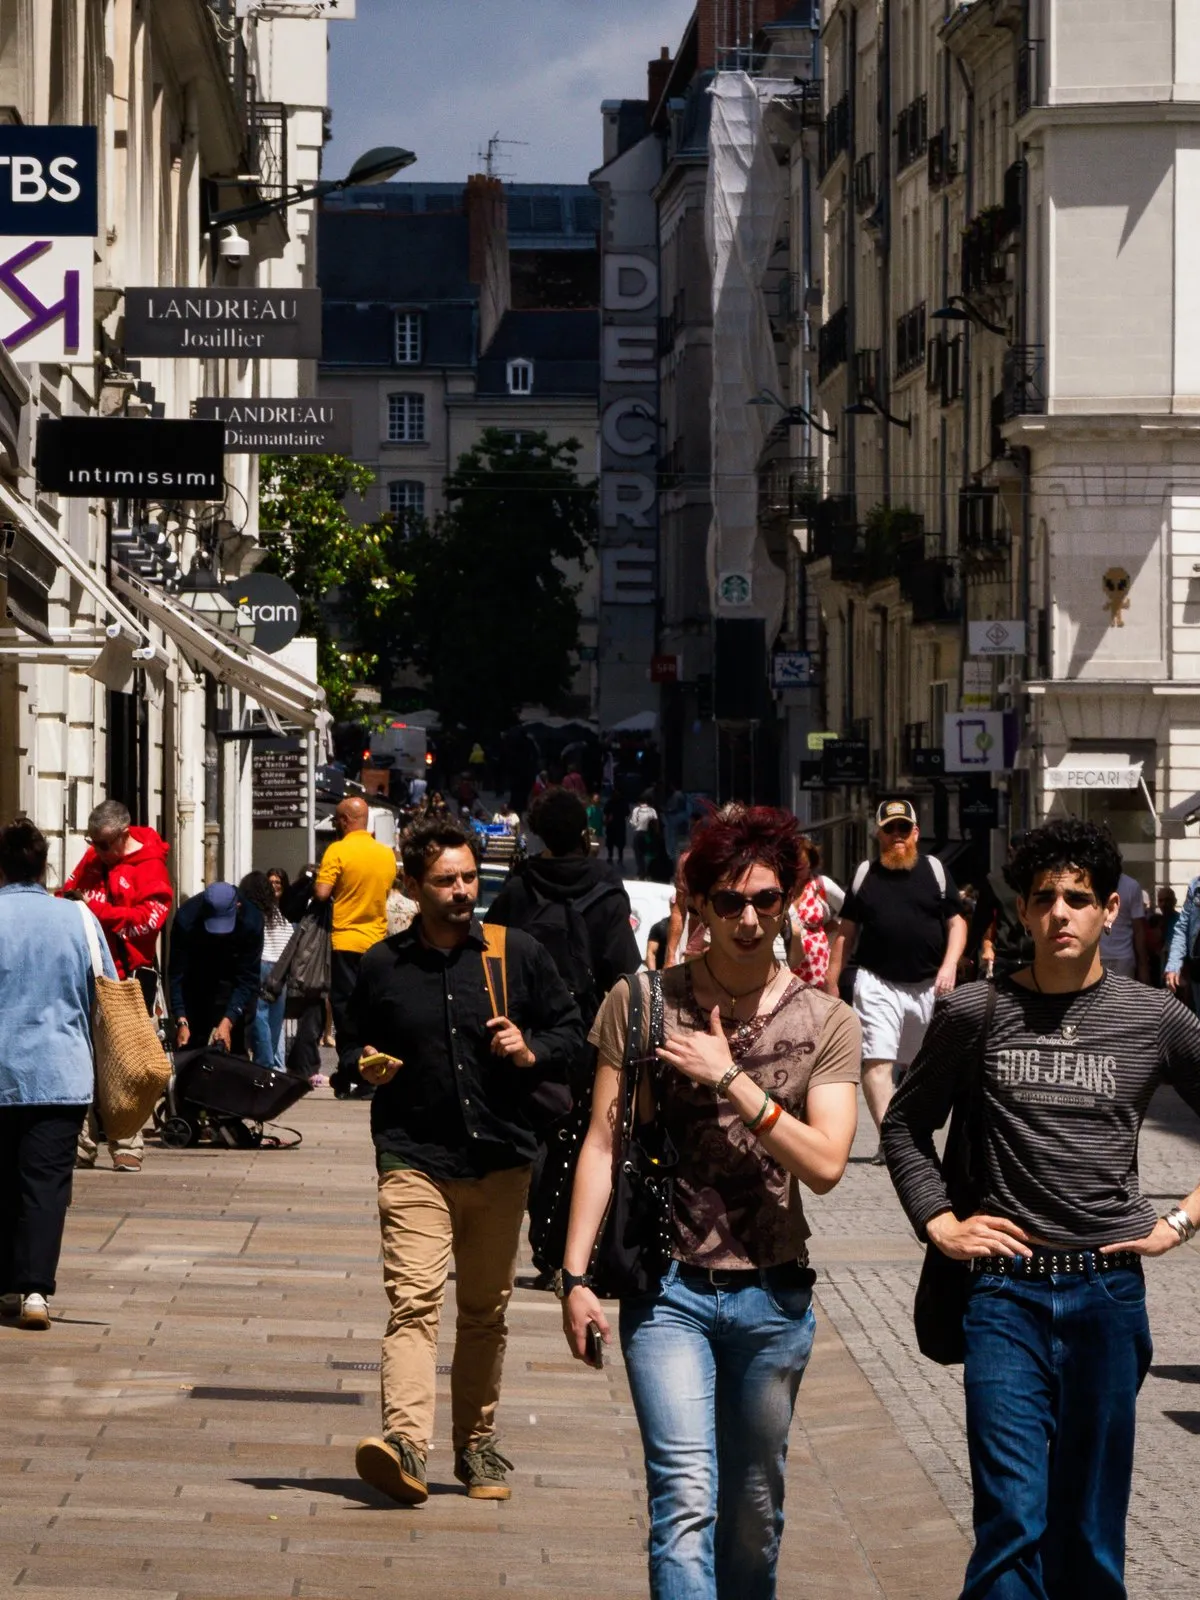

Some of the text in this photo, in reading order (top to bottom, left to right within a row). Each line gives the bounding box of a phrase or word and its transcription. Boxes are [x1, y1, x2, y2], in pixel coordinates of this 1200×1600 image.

[148, 298, 297, 319] LANDREAU
[180, 328, 265, 348] Joaillier
[214, 406, 333, 423] LANDREAU
[224, 430, 325, 446] Diamantaire
[68, 469, 216, 486] intimissimi
[1067, 770, 1120, 786] PECARI
[1045, 1051, 1117, 1099] JEANS
